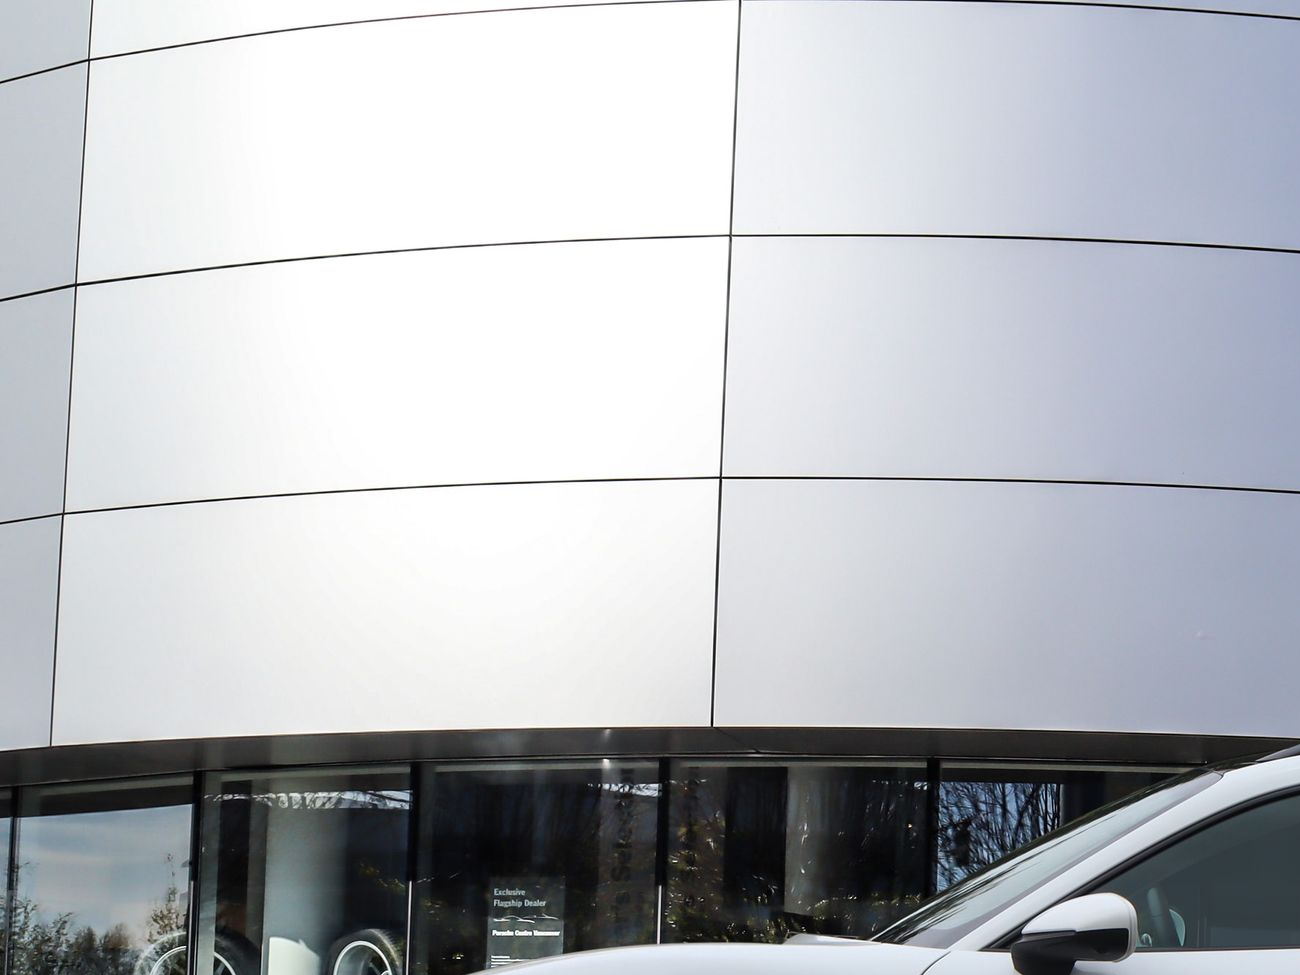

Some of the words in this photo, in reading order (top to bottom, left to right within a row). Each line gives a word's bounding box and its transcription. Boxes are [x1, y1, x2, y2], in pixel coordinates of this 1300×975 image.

[493, 888, 525, 896] Exclusive
[493, 899, 523, 908] Flagship
[524, 899, 546, 907] Dealer
